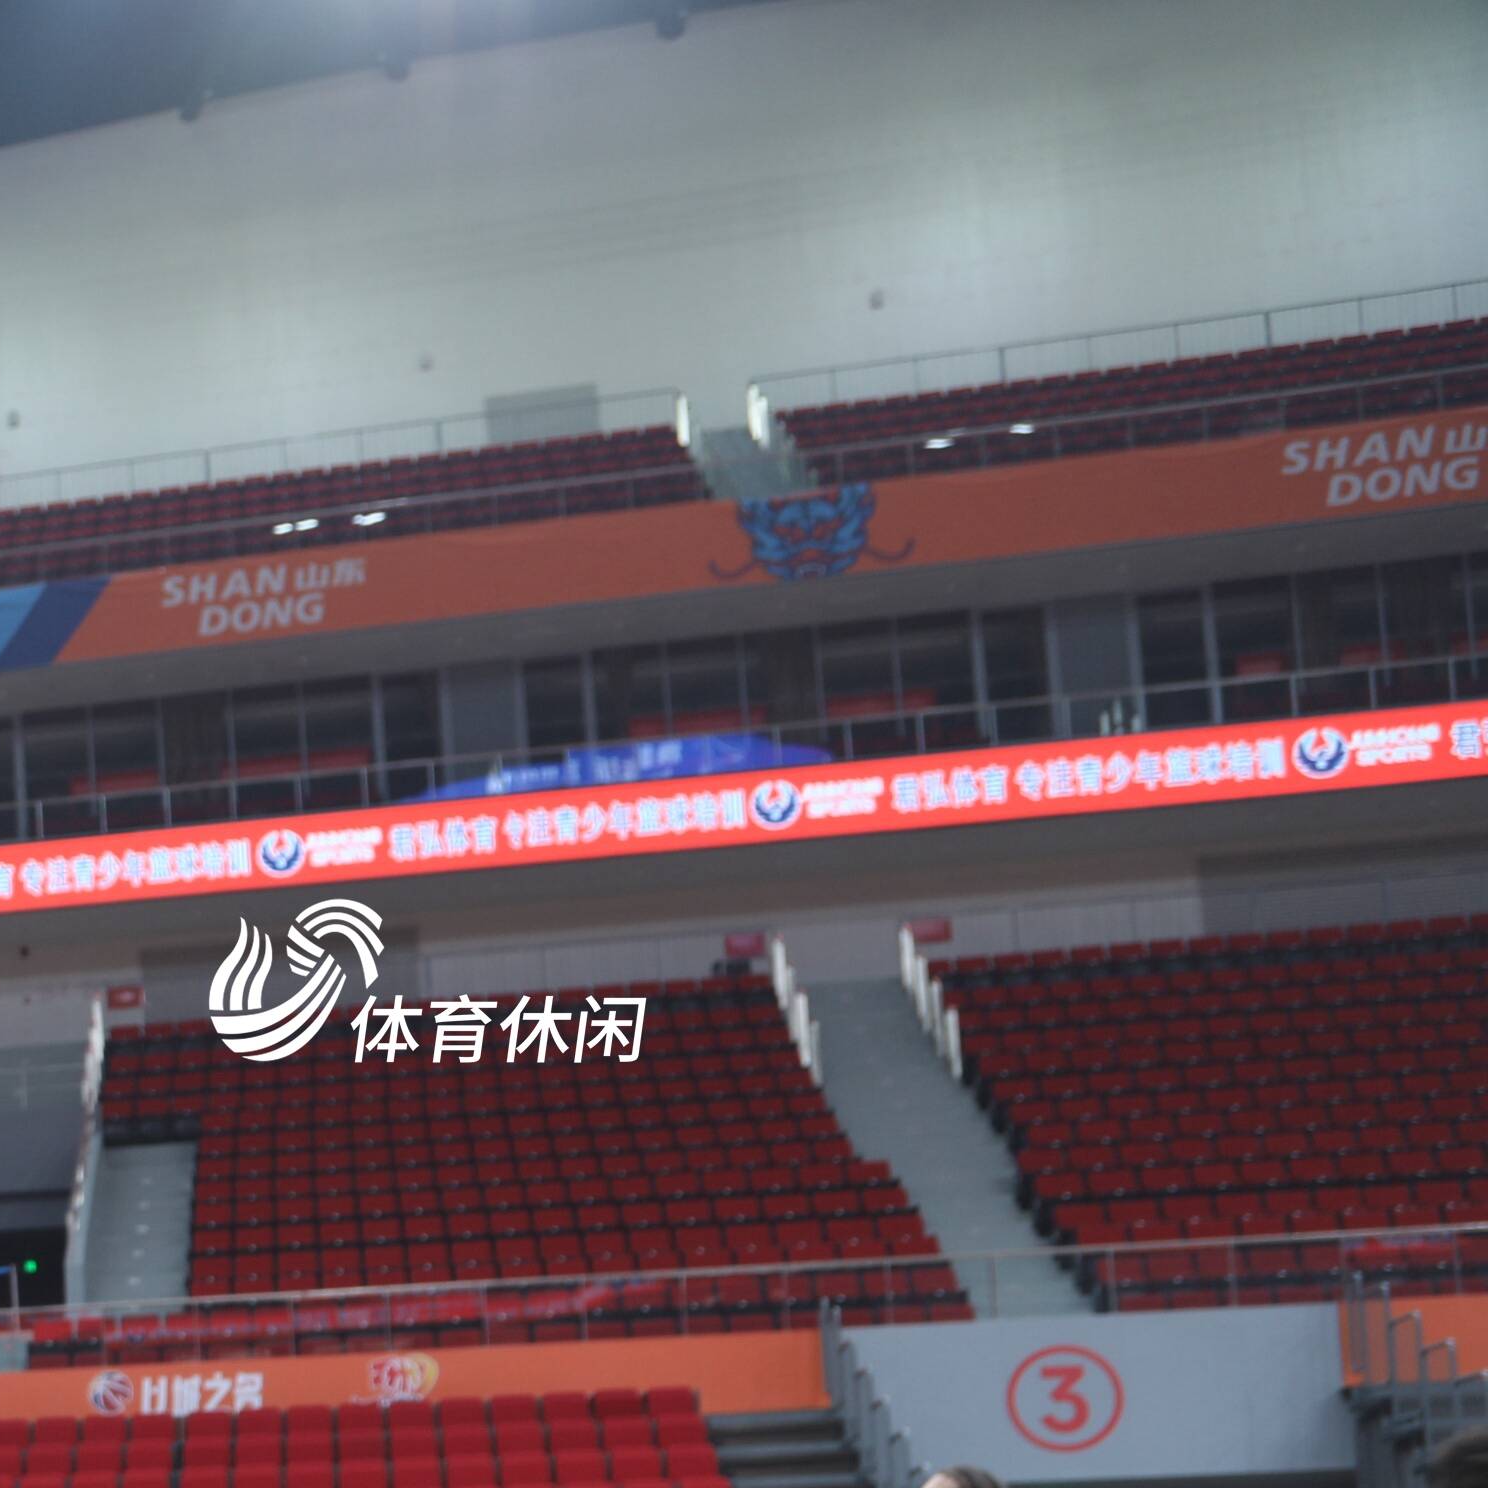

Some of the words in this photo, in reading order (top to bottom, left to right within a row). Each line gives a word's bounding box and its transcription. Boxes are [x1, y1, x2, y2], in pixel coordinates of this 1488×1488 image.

[1281, 425, 1436, 475] SHAN
[1327, 456, 1479, 507] DONG
[161, 563, 287, 608] SHAN
[198, 592, 325, 637] DONG
[1448, 717, 1488, 760] 君
[1040, 1365, 1090, 1433] 3
